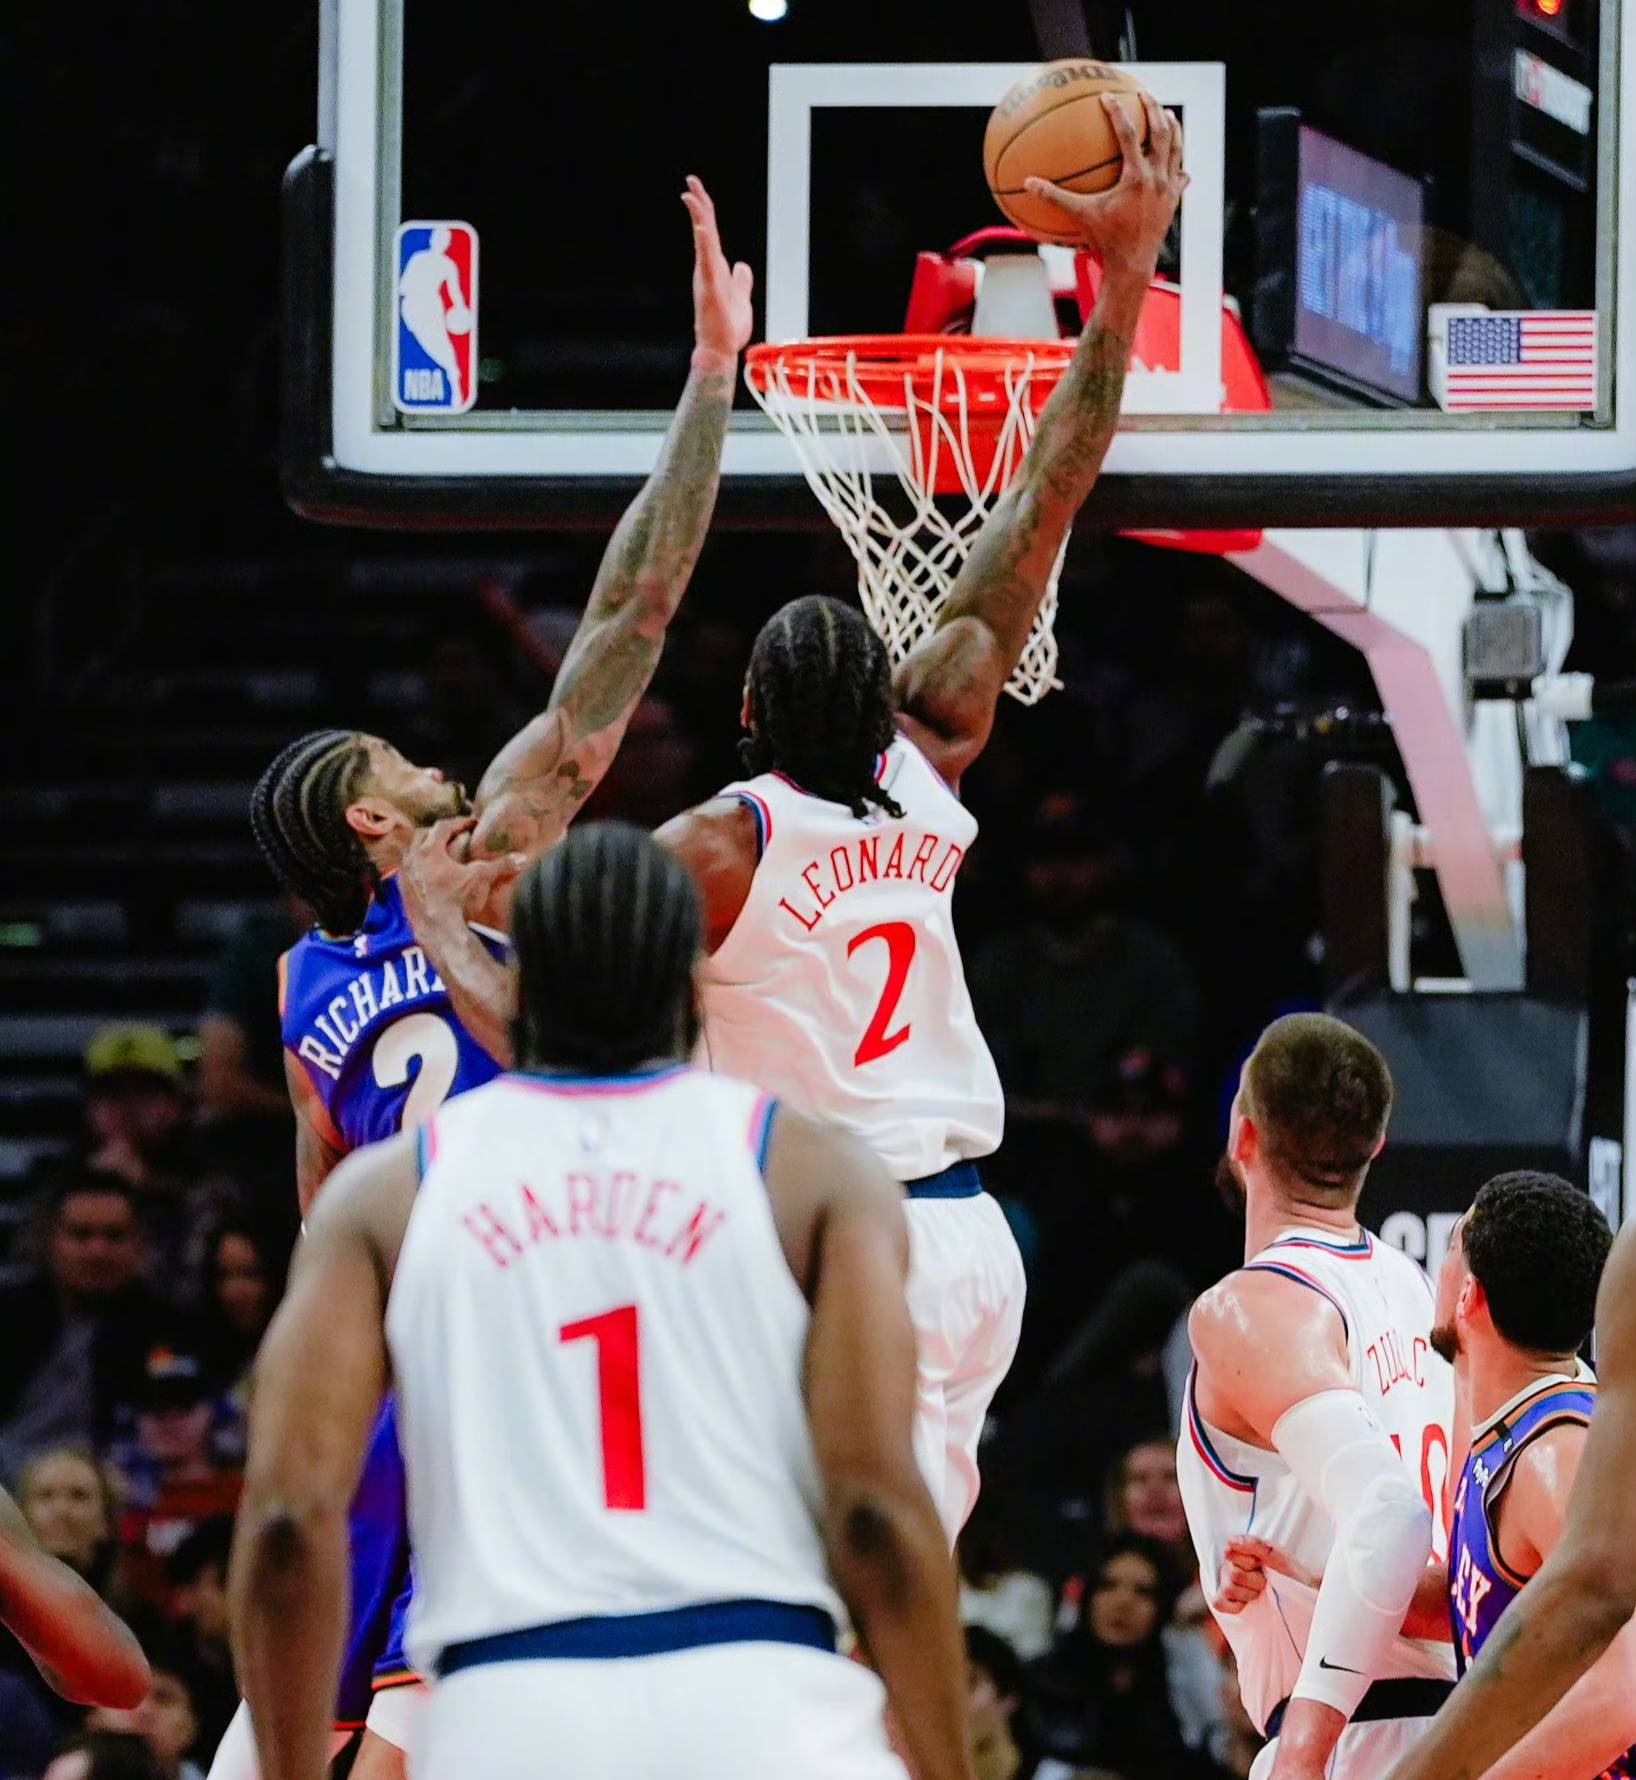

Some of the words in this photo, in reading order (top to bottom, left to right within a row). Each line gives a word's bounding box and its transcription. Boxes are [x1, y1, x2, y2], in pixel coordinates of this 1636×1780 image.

[404, 368, 445, 401] NBA
[779, 832, 965, 932] LEONARD
[298, 945, 447, 1081] RICHAR
[847, 921, 916, 1068] 2
[372, 1012, 460, 1136] 2
[461, 1171, 727, 1268] HARDEN
[560, 1304, 646, 1510] 1
